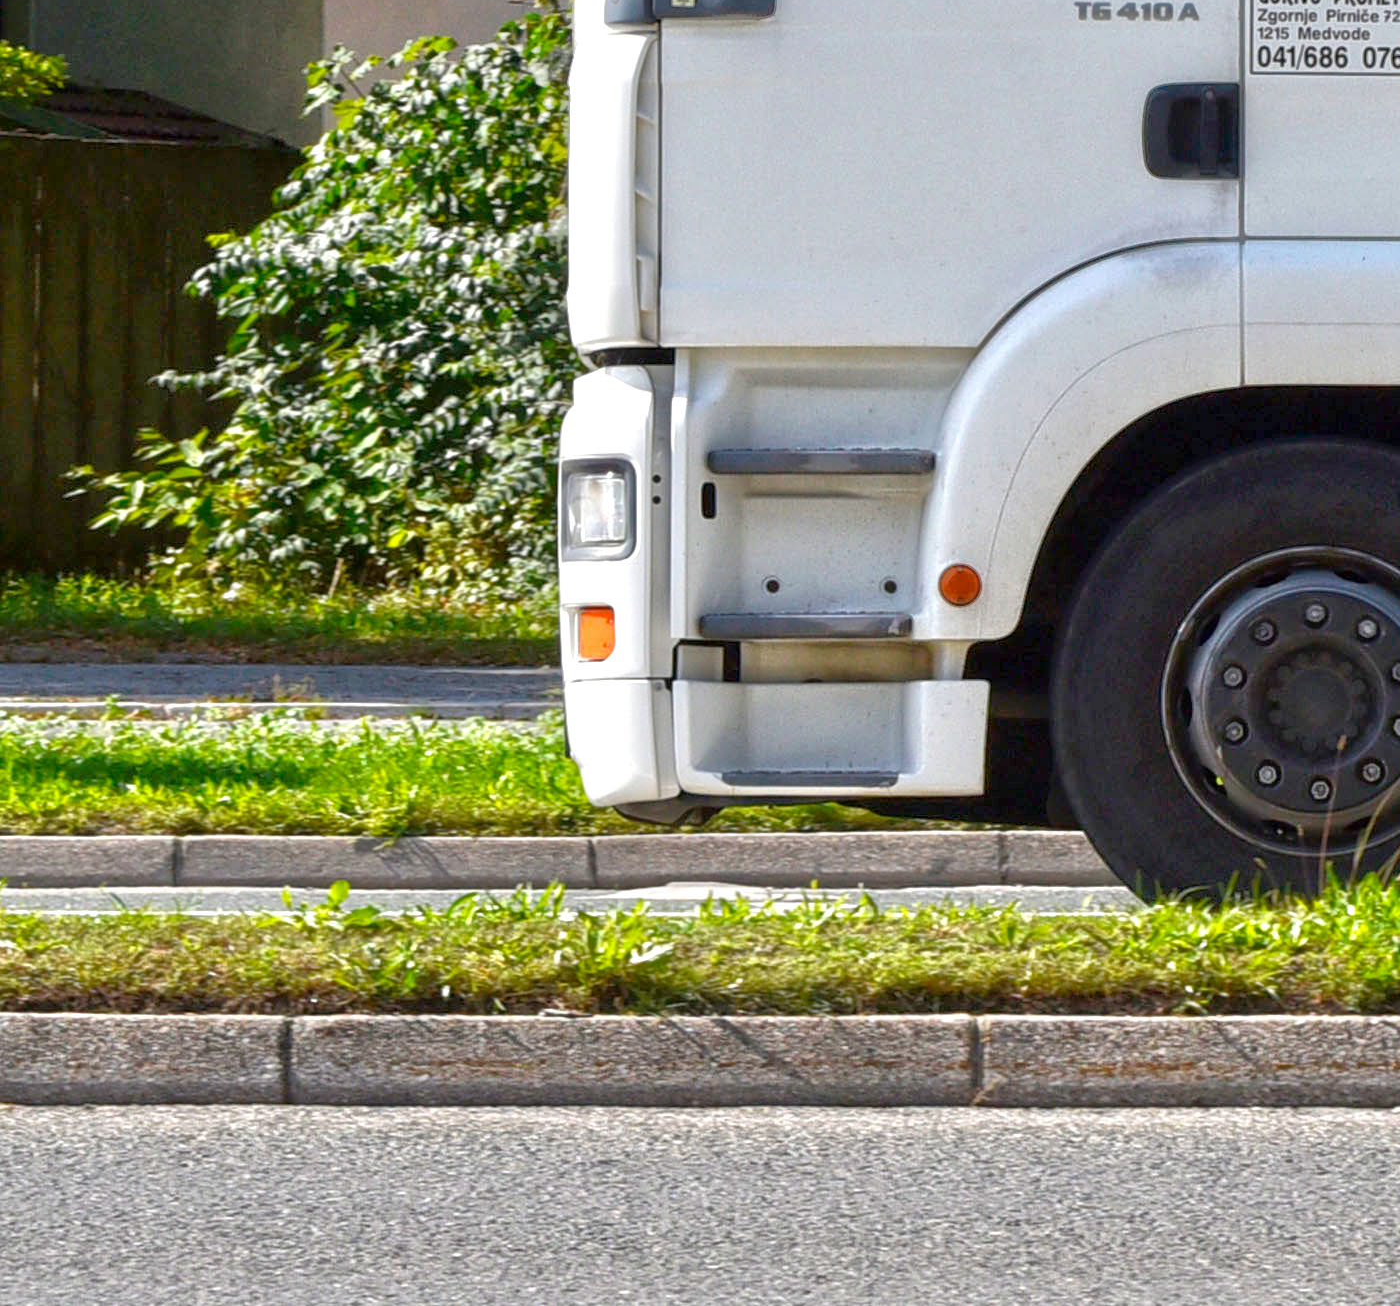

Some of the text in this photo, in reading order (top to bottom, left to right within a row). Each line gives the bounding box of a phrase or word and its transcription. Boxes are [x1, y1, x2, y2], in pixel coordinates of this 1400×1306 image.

[1116, 1, 1174, 22] 410
[1177, 2, 1200, 22] A
[1257, 8, 1400, 26] Zgornje Pirniče 72
[1257, 27, 1371, 41] 1215 Medvode
[1257, 45, 1348, 70] 041/686
